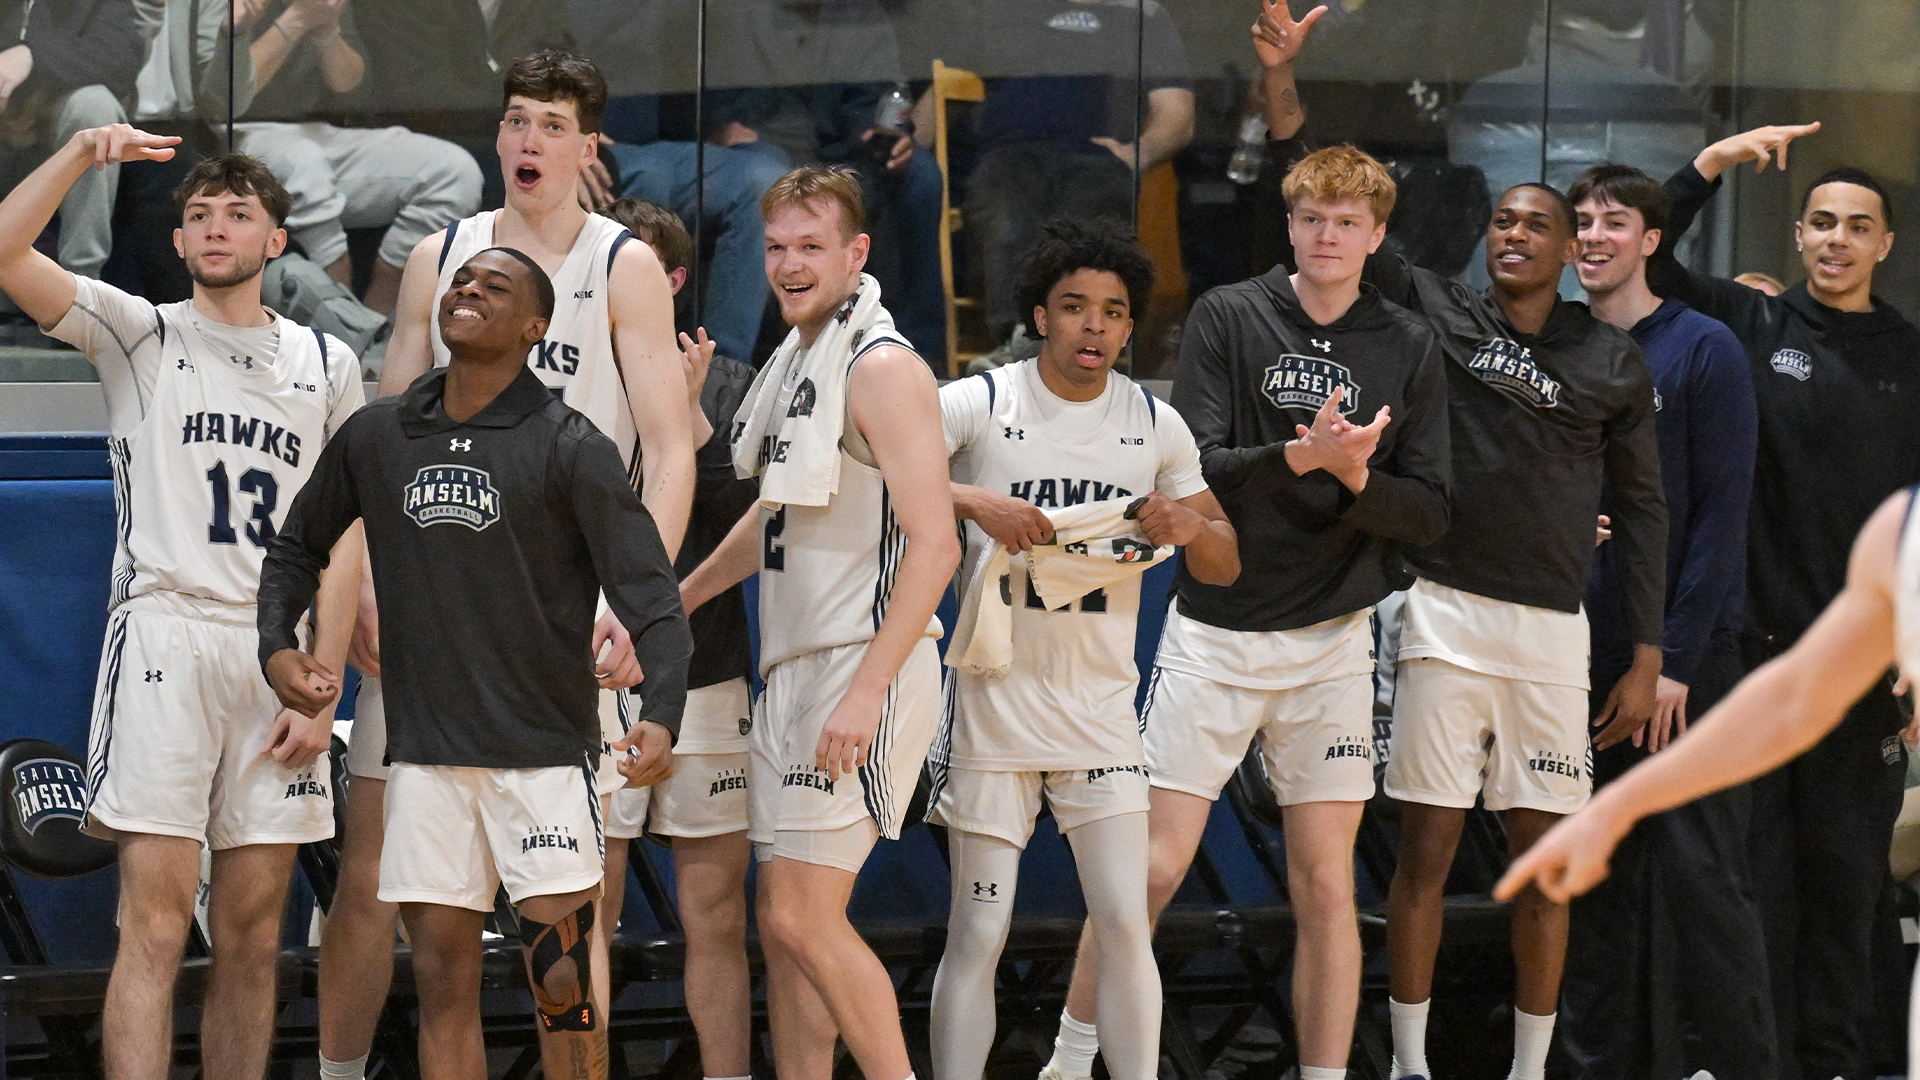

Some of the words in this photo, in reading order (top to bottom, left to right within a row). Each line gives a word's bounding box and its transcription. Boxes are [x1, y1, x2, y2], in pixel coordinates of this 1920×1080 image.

[1284, 358, 1343, 379] SAINT
[1474, 351, 1554, 402] ANSELM
[182, 411, 301, 468] HAWKS
[423, 470, 482, 486] SAINT
[206, 458, 280, 550] 13
[408, 483, 496, 515] ANSELM
[422, 507, 480, 521] BASKETBALL
[1539, 750, 1577, 763] SAINT
[20, 766, 78, 785] SAINT
[718, 768, 745, 779] SAIN
[781, 772, 834, 795] ANSELM
[529, 825, 569, 835] SAINT
[522, 834, 580, 855] ANSELM
